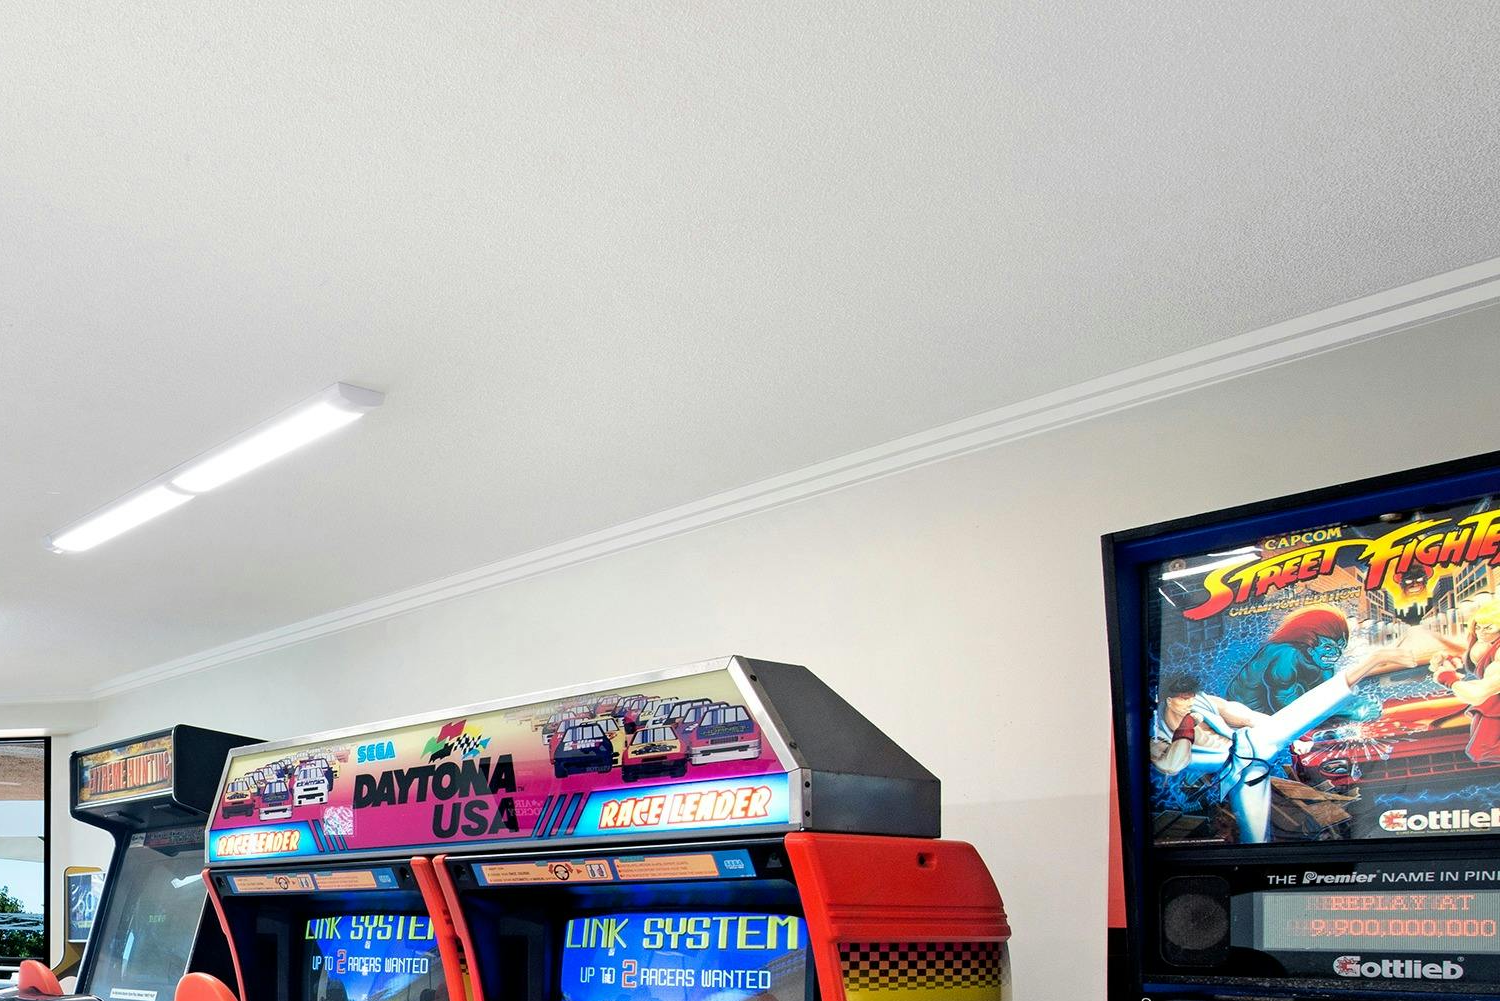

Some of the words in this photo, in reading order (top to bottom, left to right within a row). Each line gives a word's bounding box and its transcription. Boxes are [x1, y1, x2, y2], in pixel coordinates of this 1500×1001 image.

[1264, 528, 1342, 551] CAPCOM
[1183, 538, 1374, 620] STREET
[1360, 506, 1500, 591] FIGHTE
[357, 741, 396, 763] SEGA
[352, 753, 517, 809] DAYTONA
[433, 796, 520, 838] USA
[598, 797, 666, 829] RACE
[667, 786, 772, 825] LEADER
[217, 835, 251, 856] RACE
[250, 829, 300, 853] LEADER
[1267, 875, 1297, 885] THE
[1302, 871, 1376, 885] Premier
[1382, 871, 1435, 882] NAME
[1440, 871, 1459, 882] IN
[1464, 870, 1500, 881] PIN
[1331, 895, 1427, 911] REPLAY
[1436, 895, 1475, 910] AT
[305, 916, 341, 940] LINK
[566, 918, 629, 949] LINK
[642, 915, 799, 951] SYSTEM
[312, 957, 322, 970] UP
[324, 958, 333, 970] TO
[336, 949, 347, 974] 2
[348, 957, 381, 972] RACERS
[385, 957, 429, 974] WANTED
[580, 966, 595, 983] UP
[601, 968, 615, 984] TO
[621, 959, 638, 988] 2
[640, 968, 695, 987] RACERS
[701, 969, 771, 989] WANTED
[1332, 955, 1464, 980] Gottlieb
